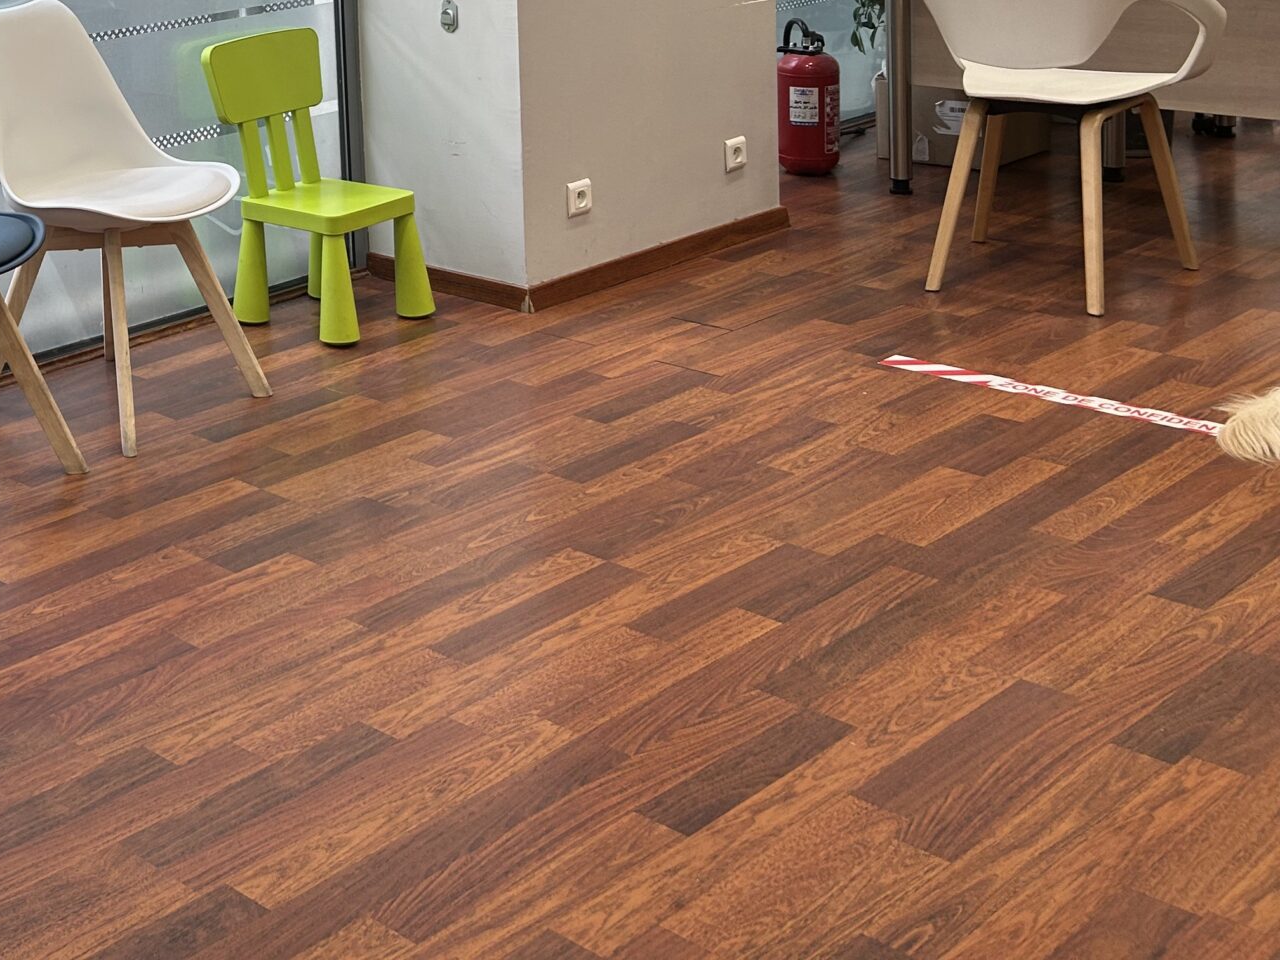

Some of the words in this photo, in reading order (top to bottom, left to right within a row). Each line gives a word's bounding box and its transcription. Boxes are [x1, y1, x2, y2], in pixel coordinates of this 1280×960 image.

[999, 381, 1060, 397] ZONE
[1062, 395, 1096, 405] DE
[1098, 402, 1217, 431] CONFIDEN
